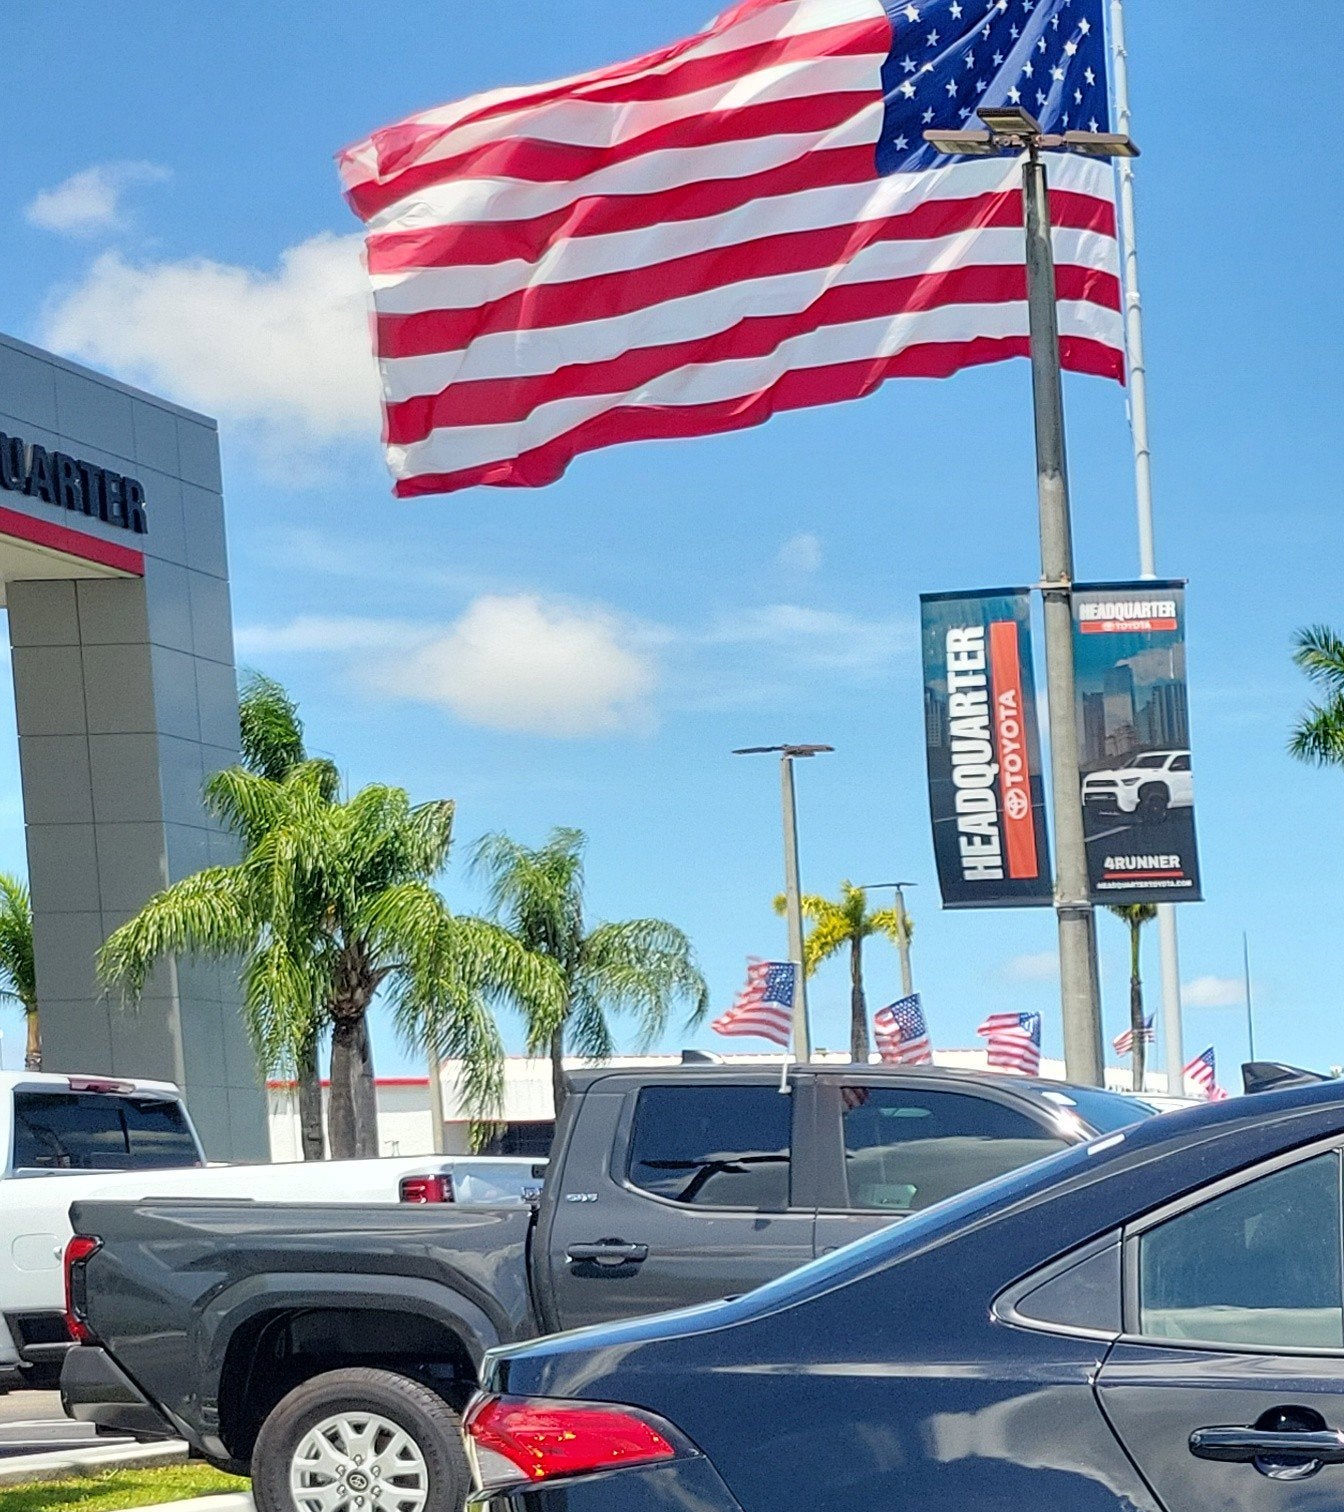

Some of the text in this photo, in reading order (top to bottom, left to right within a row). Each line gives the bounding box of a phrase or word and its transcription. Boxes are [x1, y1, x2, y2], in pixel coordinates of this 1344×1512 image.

[0, 431, 148, 534] UARTER
[1080, 601, 1176, 621] HEADQUARTER
[946, 625, 1004, 880] HEADQUARTER
[999, 688, 1024, 787] TOYOTA
[1104, 854, 1181, 869] 4RUNNER
